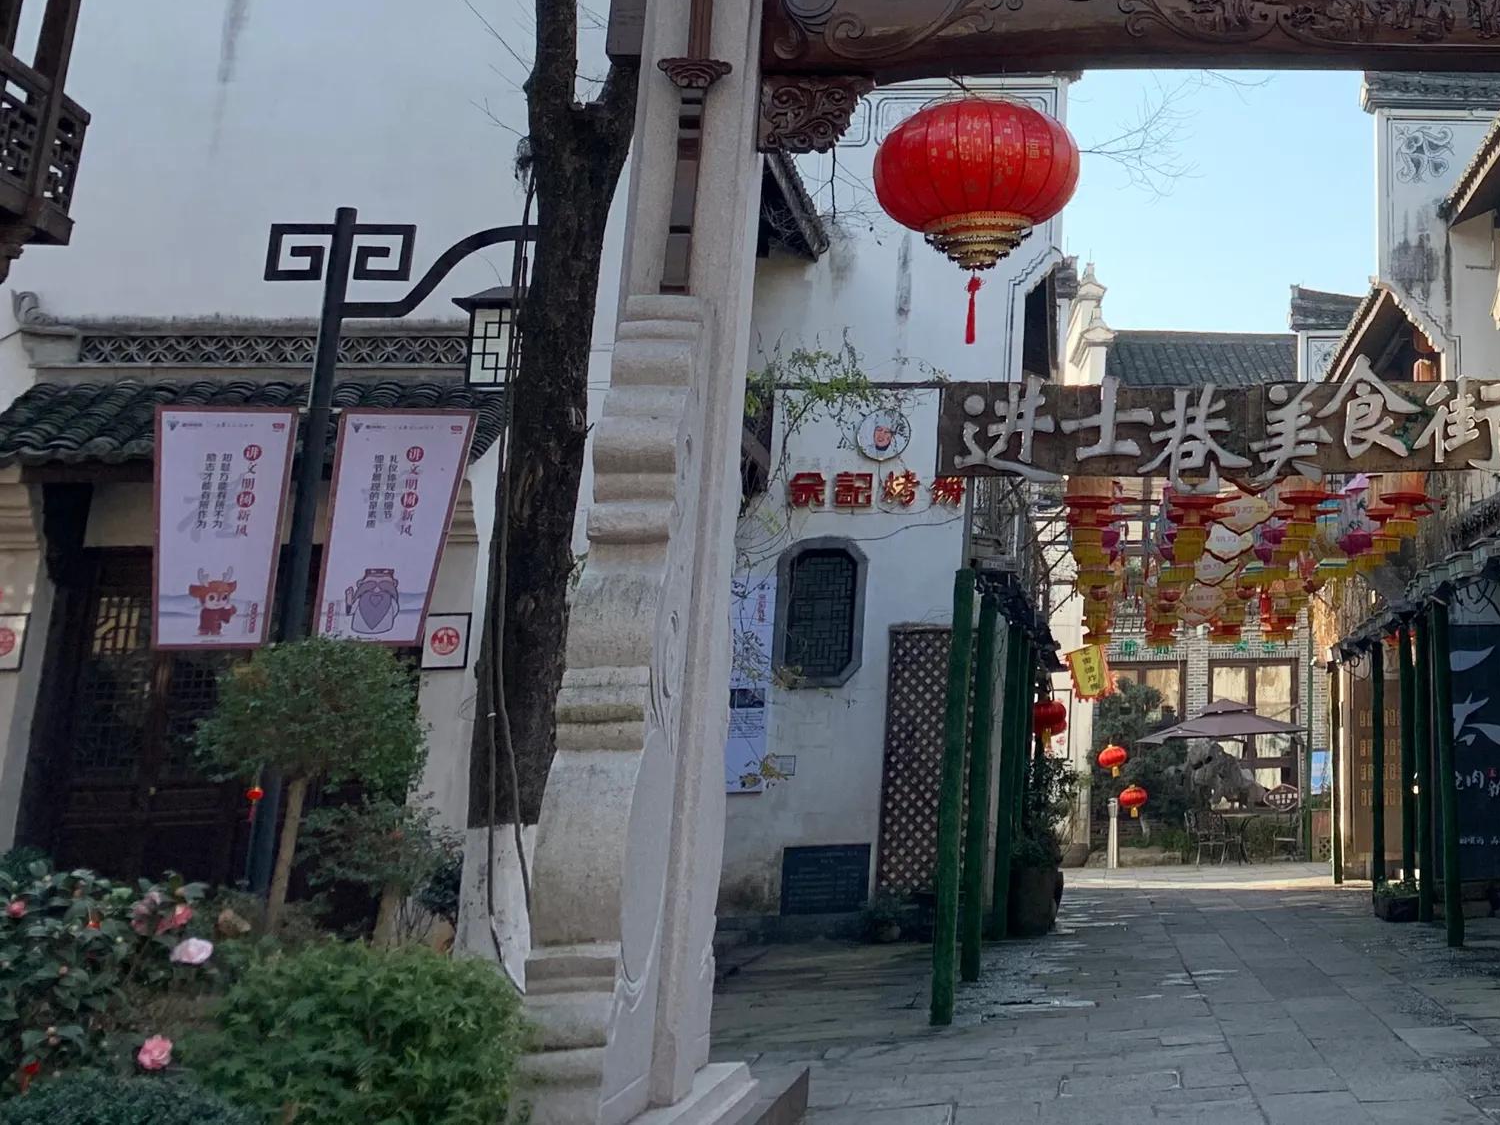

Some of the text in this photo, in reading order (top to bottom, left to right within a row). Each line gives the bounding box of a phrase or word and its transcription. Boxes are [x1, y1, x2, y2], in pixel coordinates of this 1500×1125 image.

[235, 445, 262, 537] 讲文明树新风
[400, 446, 424, 537] 讲文明树新风
